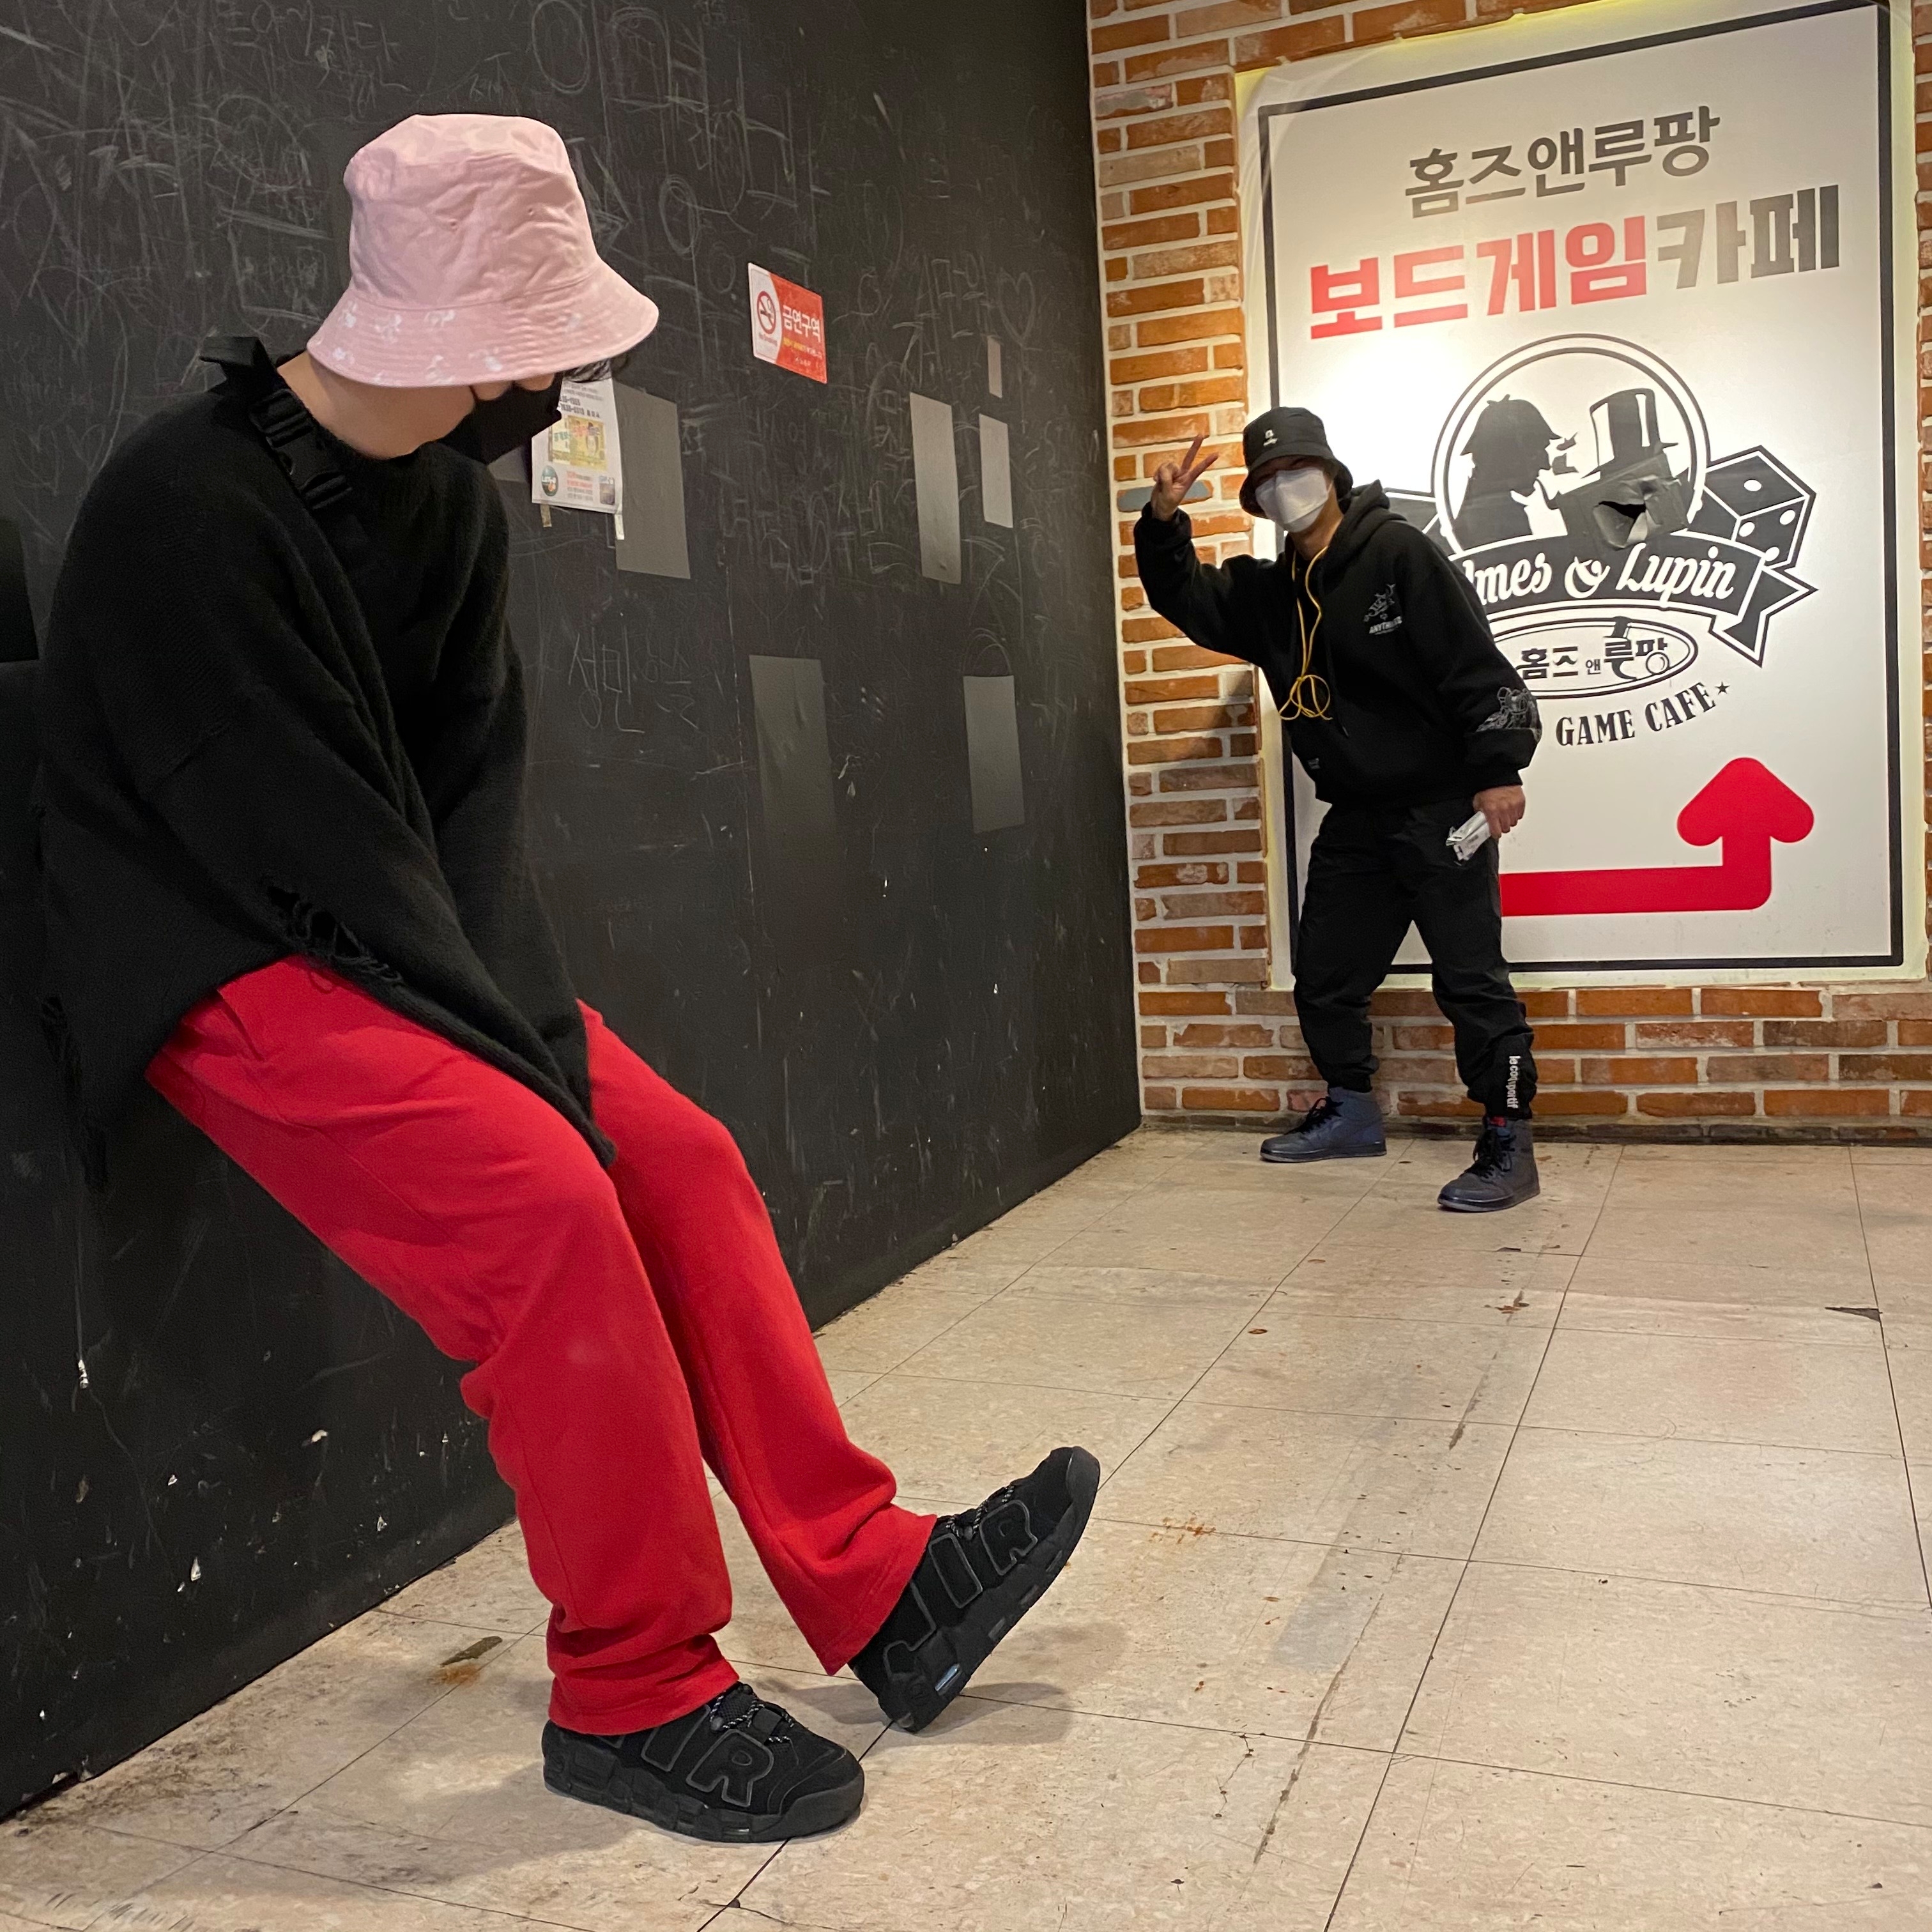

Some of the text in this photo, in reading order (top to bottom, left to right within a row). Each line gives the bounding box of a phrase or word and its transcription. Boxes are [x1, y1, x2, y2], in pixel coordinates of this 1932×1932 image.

[1406, 105, 1721, 218] 홈즈앤루팡
[1310, 184, 1841, 340] 보드게임카페
[782, 305, 821, 343] 금연구역
[1614, 542, 1737, 608] Lupin
[1555, 682, 1717, 746] GAME CAFE
